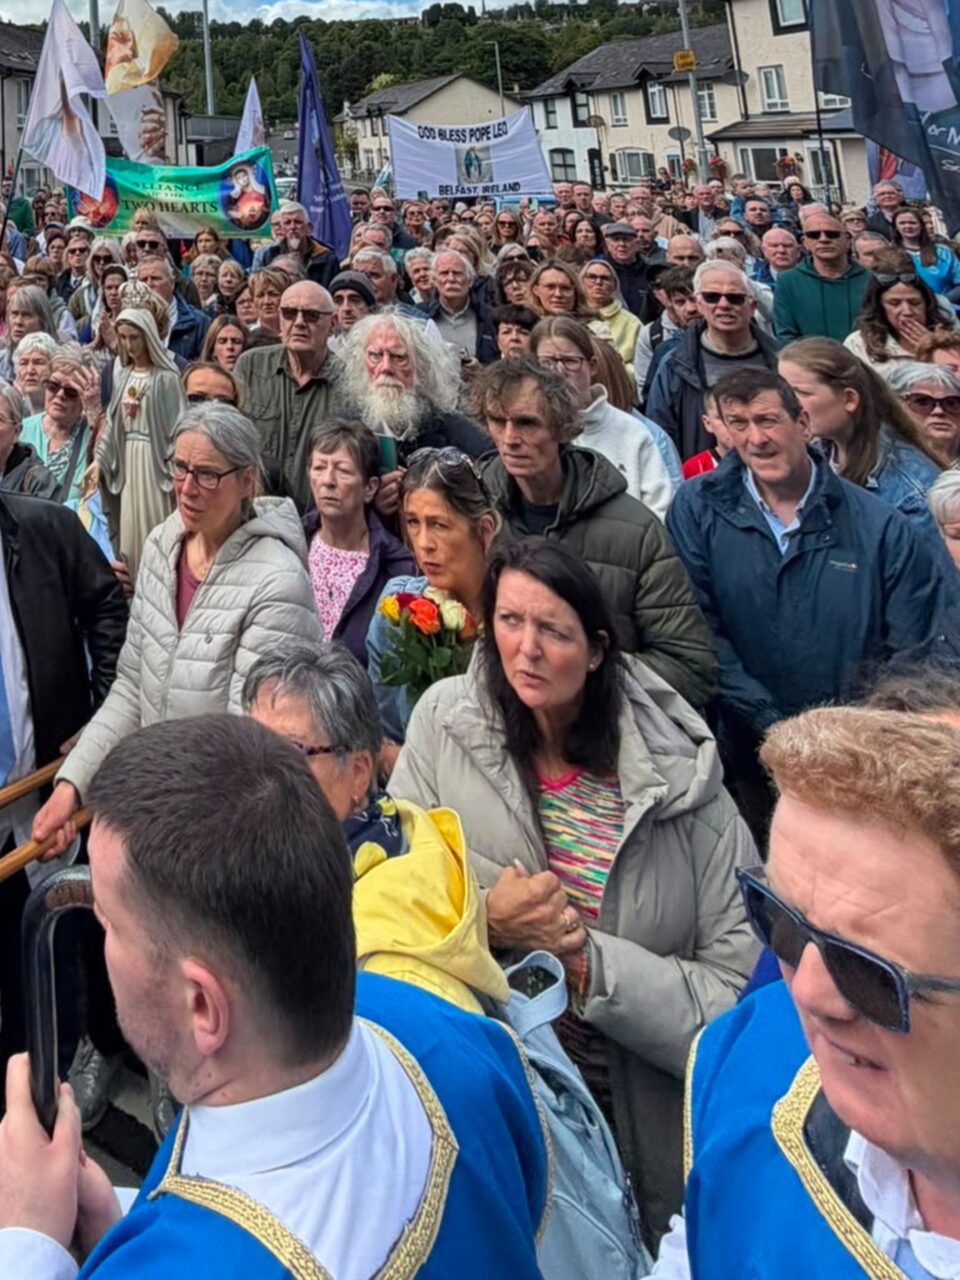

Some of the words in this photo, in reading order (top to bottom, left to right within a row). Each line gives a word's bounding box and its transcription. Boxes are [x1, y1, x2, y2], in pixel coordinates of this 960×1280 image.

[417, 125, 436, 139] GOD
[438, 128, 466, 143] BLESS
[469, 125, 492, 143] POPE
[493, 121, 508, 138] LEO
[131, 181, 200, 191] ALLIANCE
[482, 181, 521, 194] IRELAND
[122, 200, 155, 211] TWO
[159, 201, 218, 213] HEARTS
